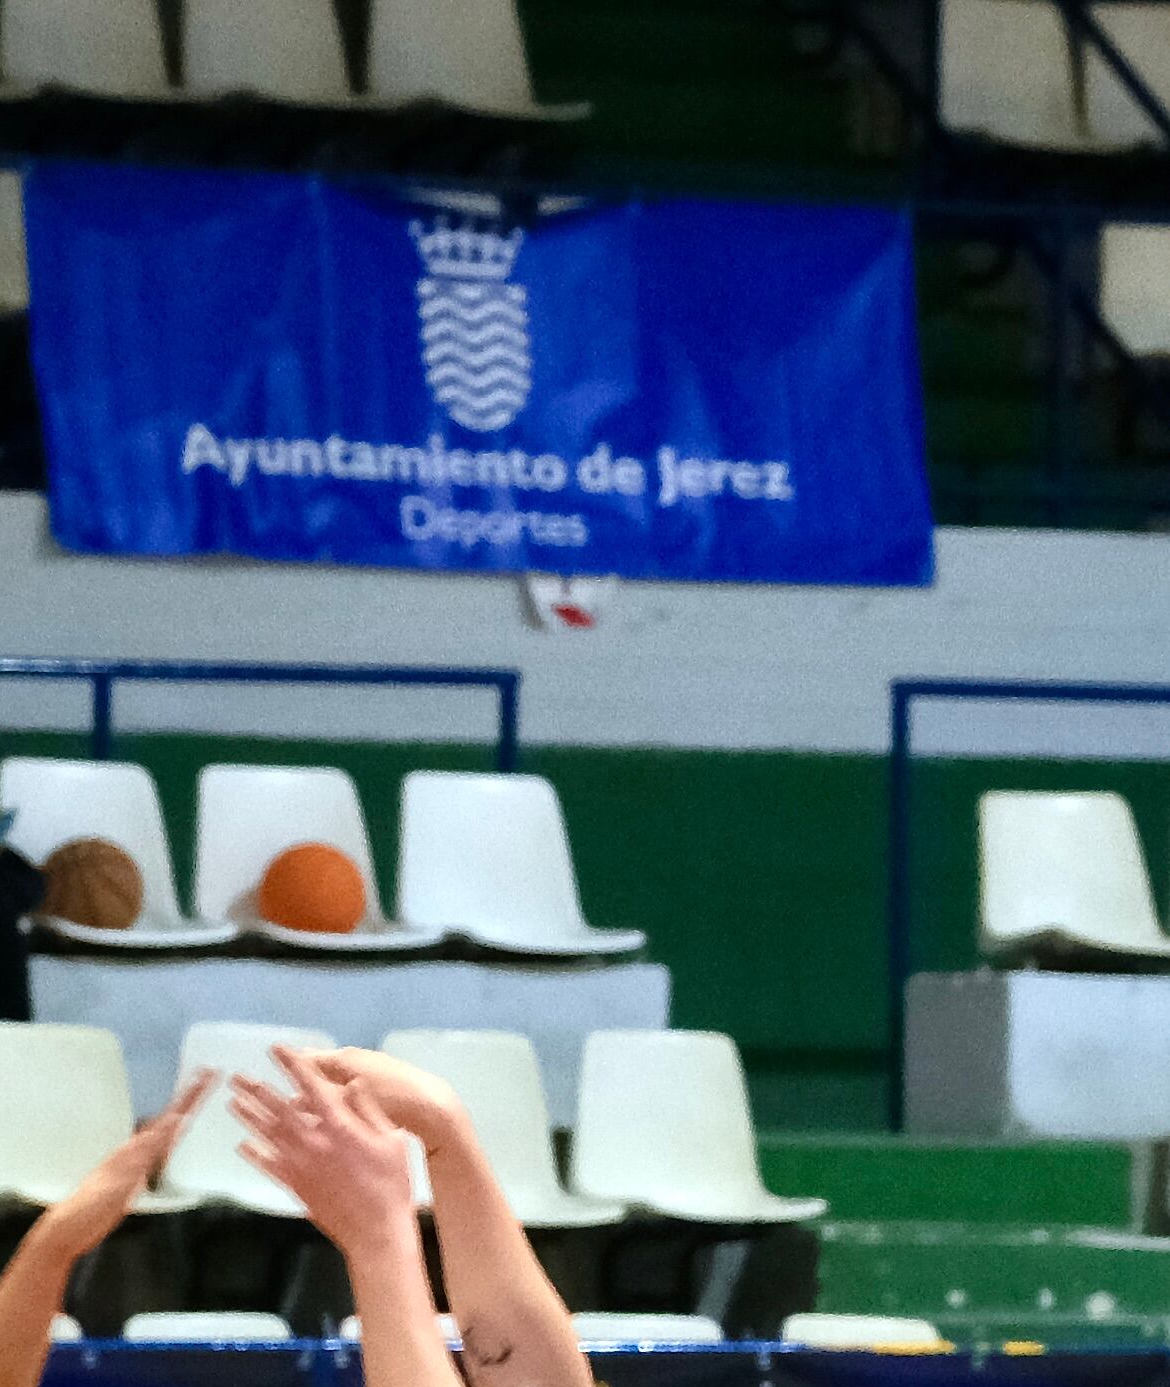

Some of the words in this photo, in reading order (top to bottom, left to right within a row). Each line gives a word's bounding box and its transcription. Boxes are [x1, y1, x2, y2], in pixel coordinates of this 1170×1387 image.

[182, 423, 568, 487] Ayuntamiento
[577, 442, 646, 497] de
[657, 444, 795, 507] Jerez
[399, 495, 589, 548] Deportes
